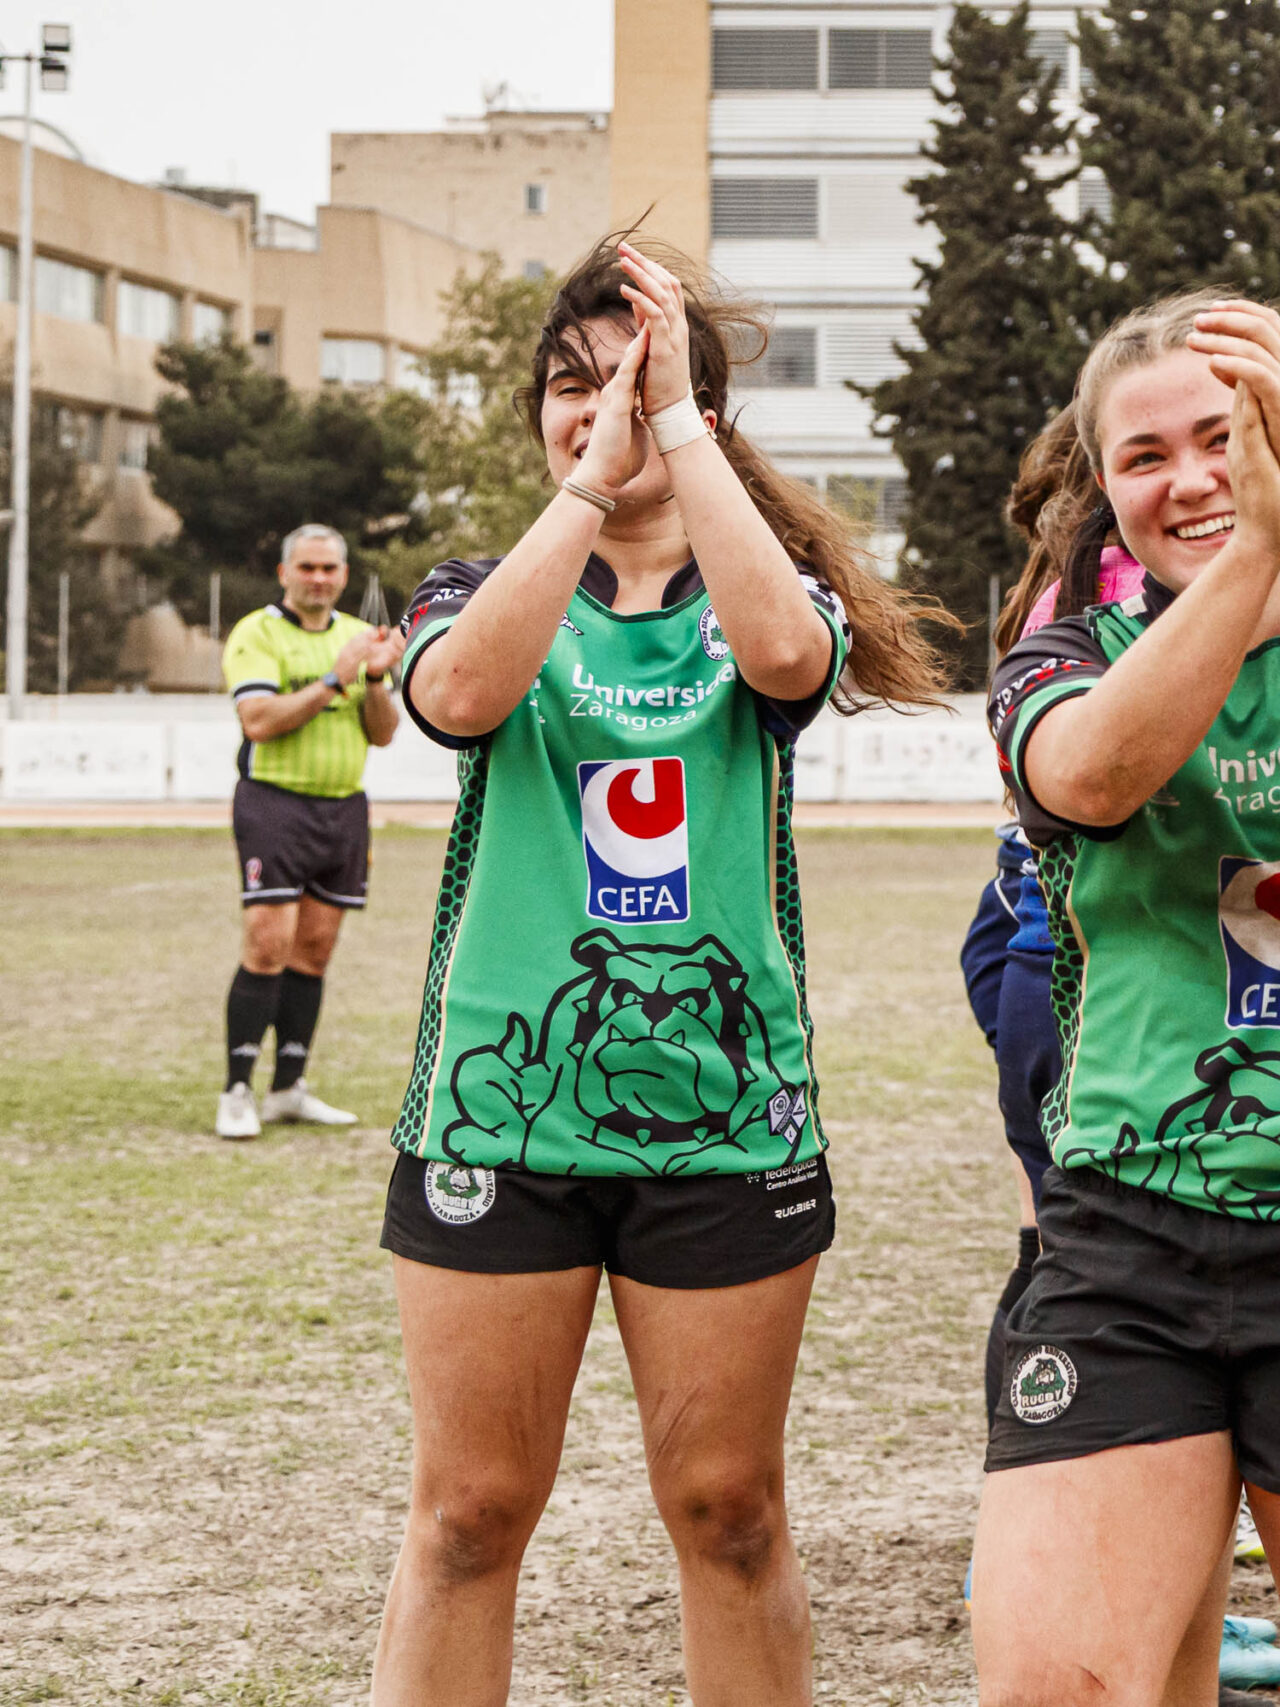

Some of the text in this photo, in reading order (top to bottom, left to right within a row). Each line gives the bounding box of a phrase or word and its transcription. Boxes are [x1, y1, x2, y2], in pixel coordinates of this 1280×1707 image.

[569, 693, 697, 732] Zaragoza
[597, 885, 680, 917] CEFA
[433, 1204, 477, 1222] ZARAGOZA
[1021, 1388, 1063, 1409] RUGBY
